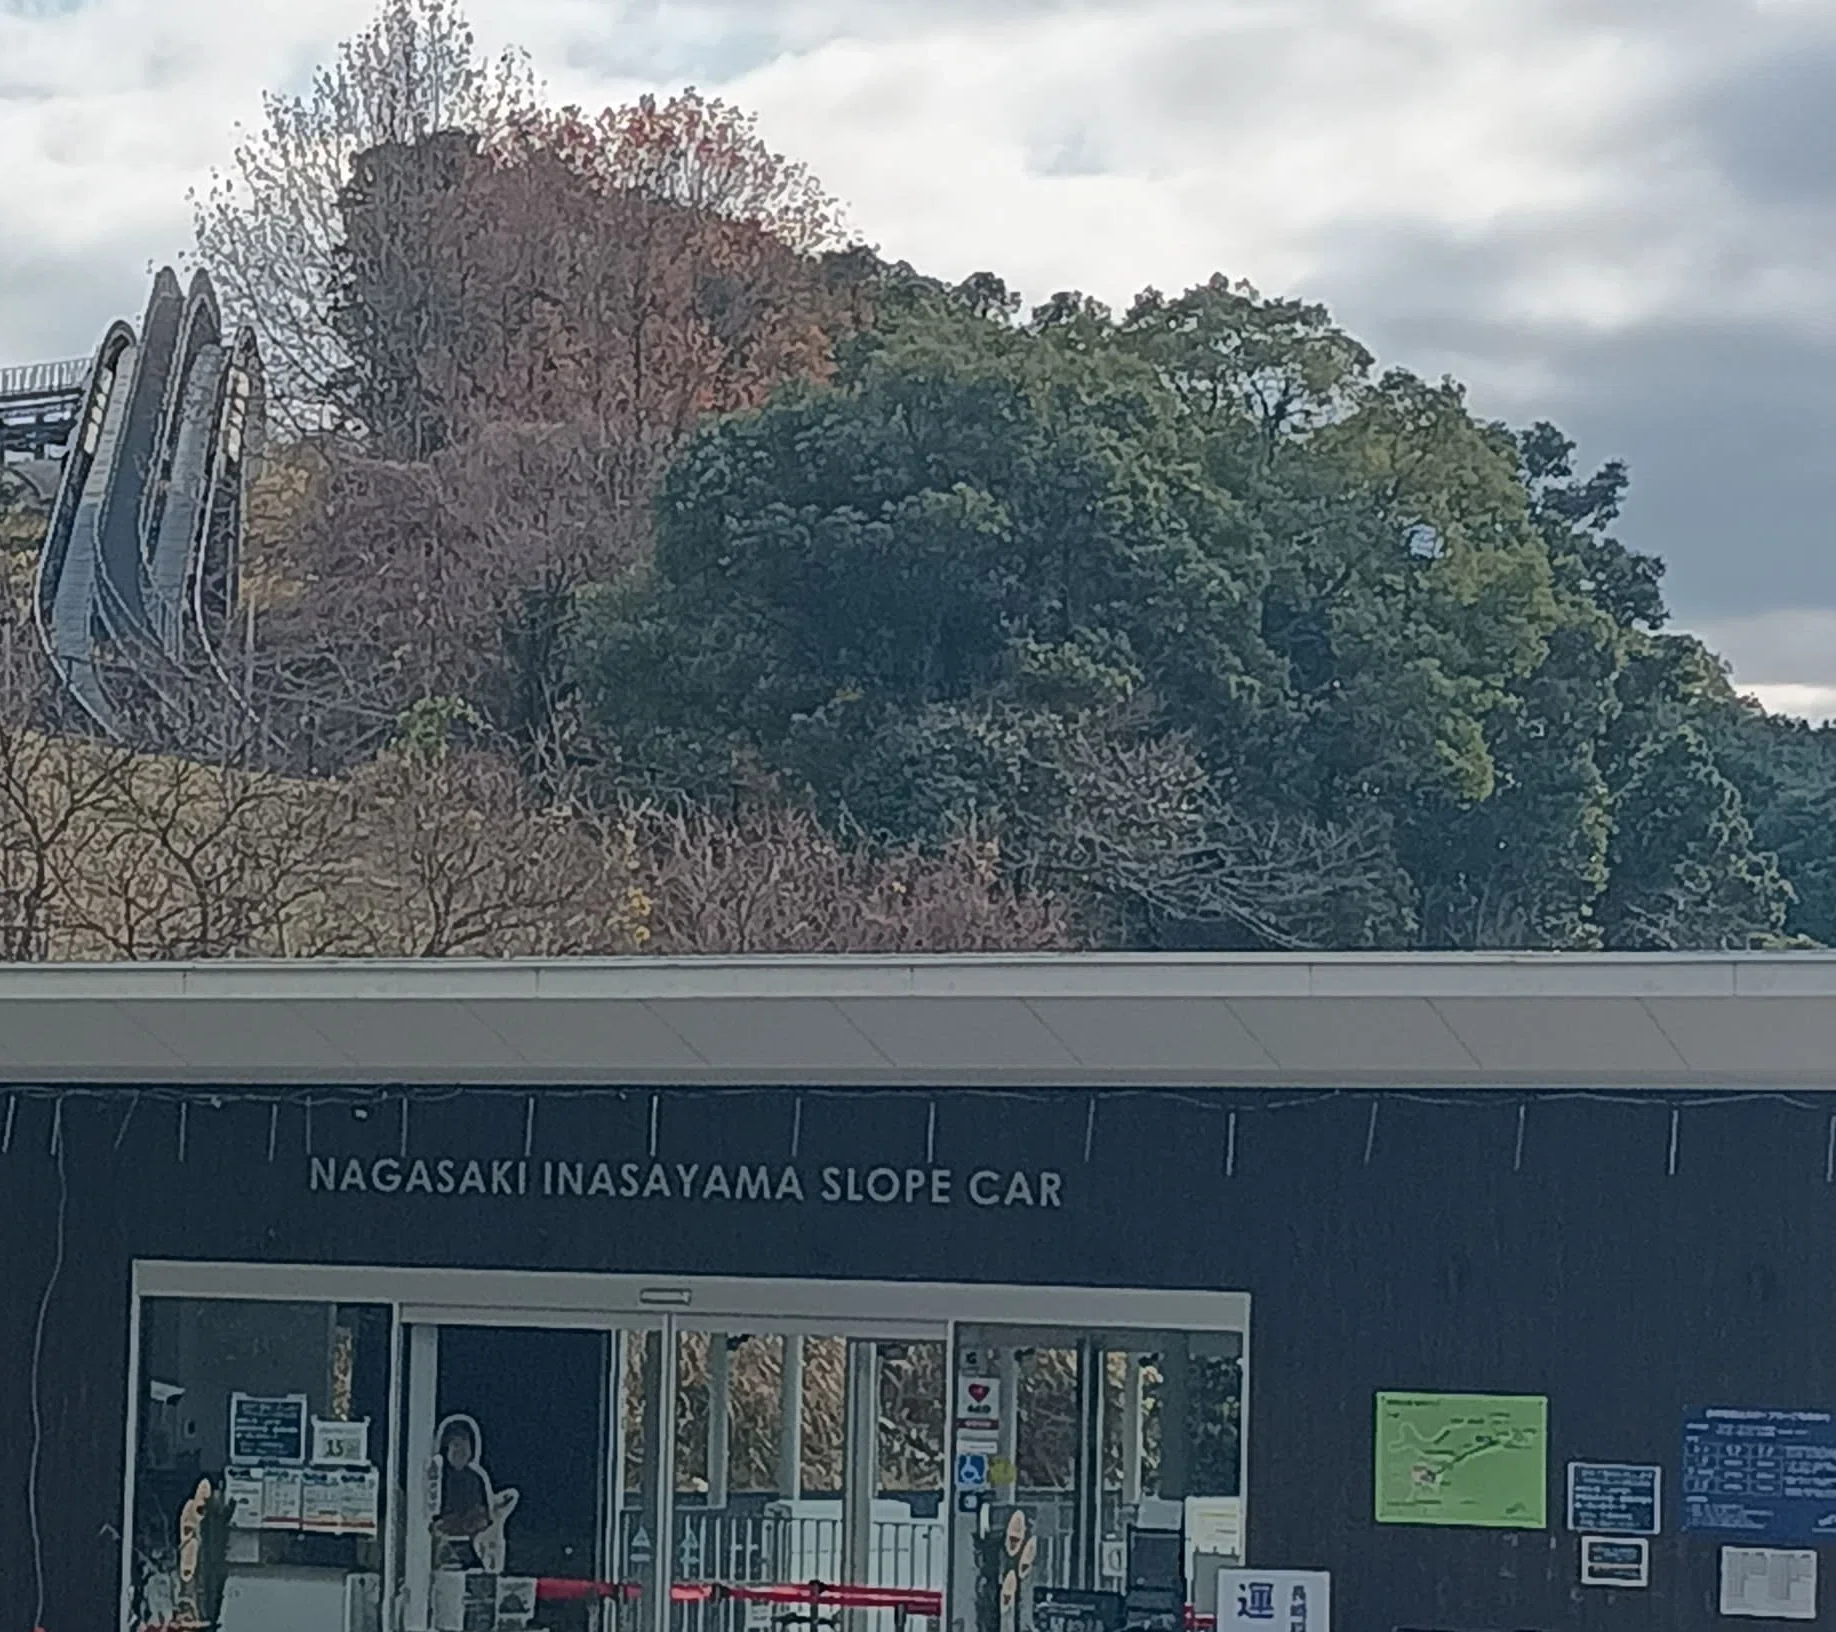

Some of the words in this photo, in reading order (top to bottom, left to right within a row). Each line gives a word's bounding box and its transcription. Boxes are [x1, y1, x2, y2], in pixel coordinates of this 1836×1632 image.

[309, 1156, 527, 1194] NAGASAKI
[544, 1161, 804, 1201] INASAYAMA
[821, 1166, 952, 1204] SLOPE
[968, 1169, 1063, 1208] CAR
